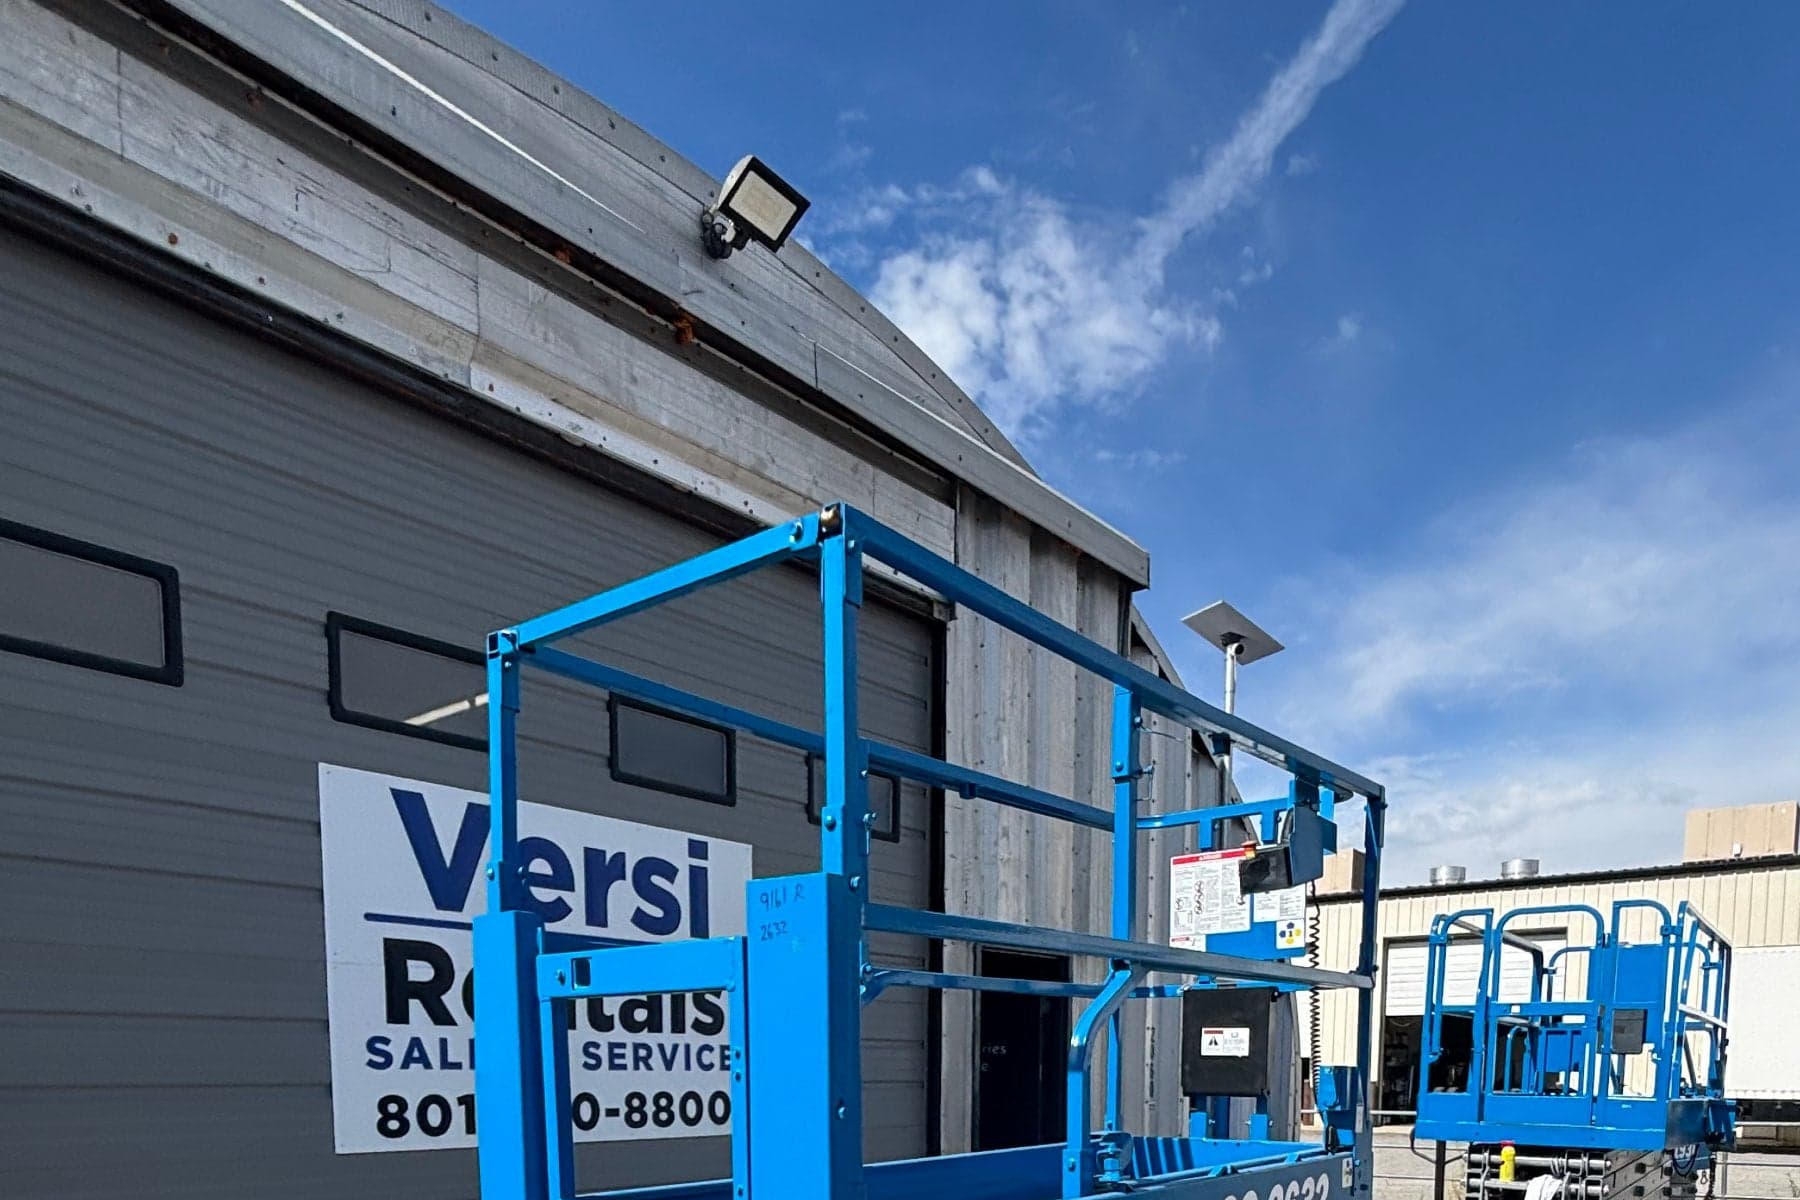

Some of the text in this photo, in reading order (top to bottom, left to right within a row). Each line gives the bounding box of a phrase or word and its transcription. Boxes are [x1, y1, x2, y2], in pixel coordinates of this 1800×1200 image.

[389, 787, 710, 940] Versi
[760, 920, 788, 942] 2632
[365, 1035, 731, 1072] SAL SERVICE
